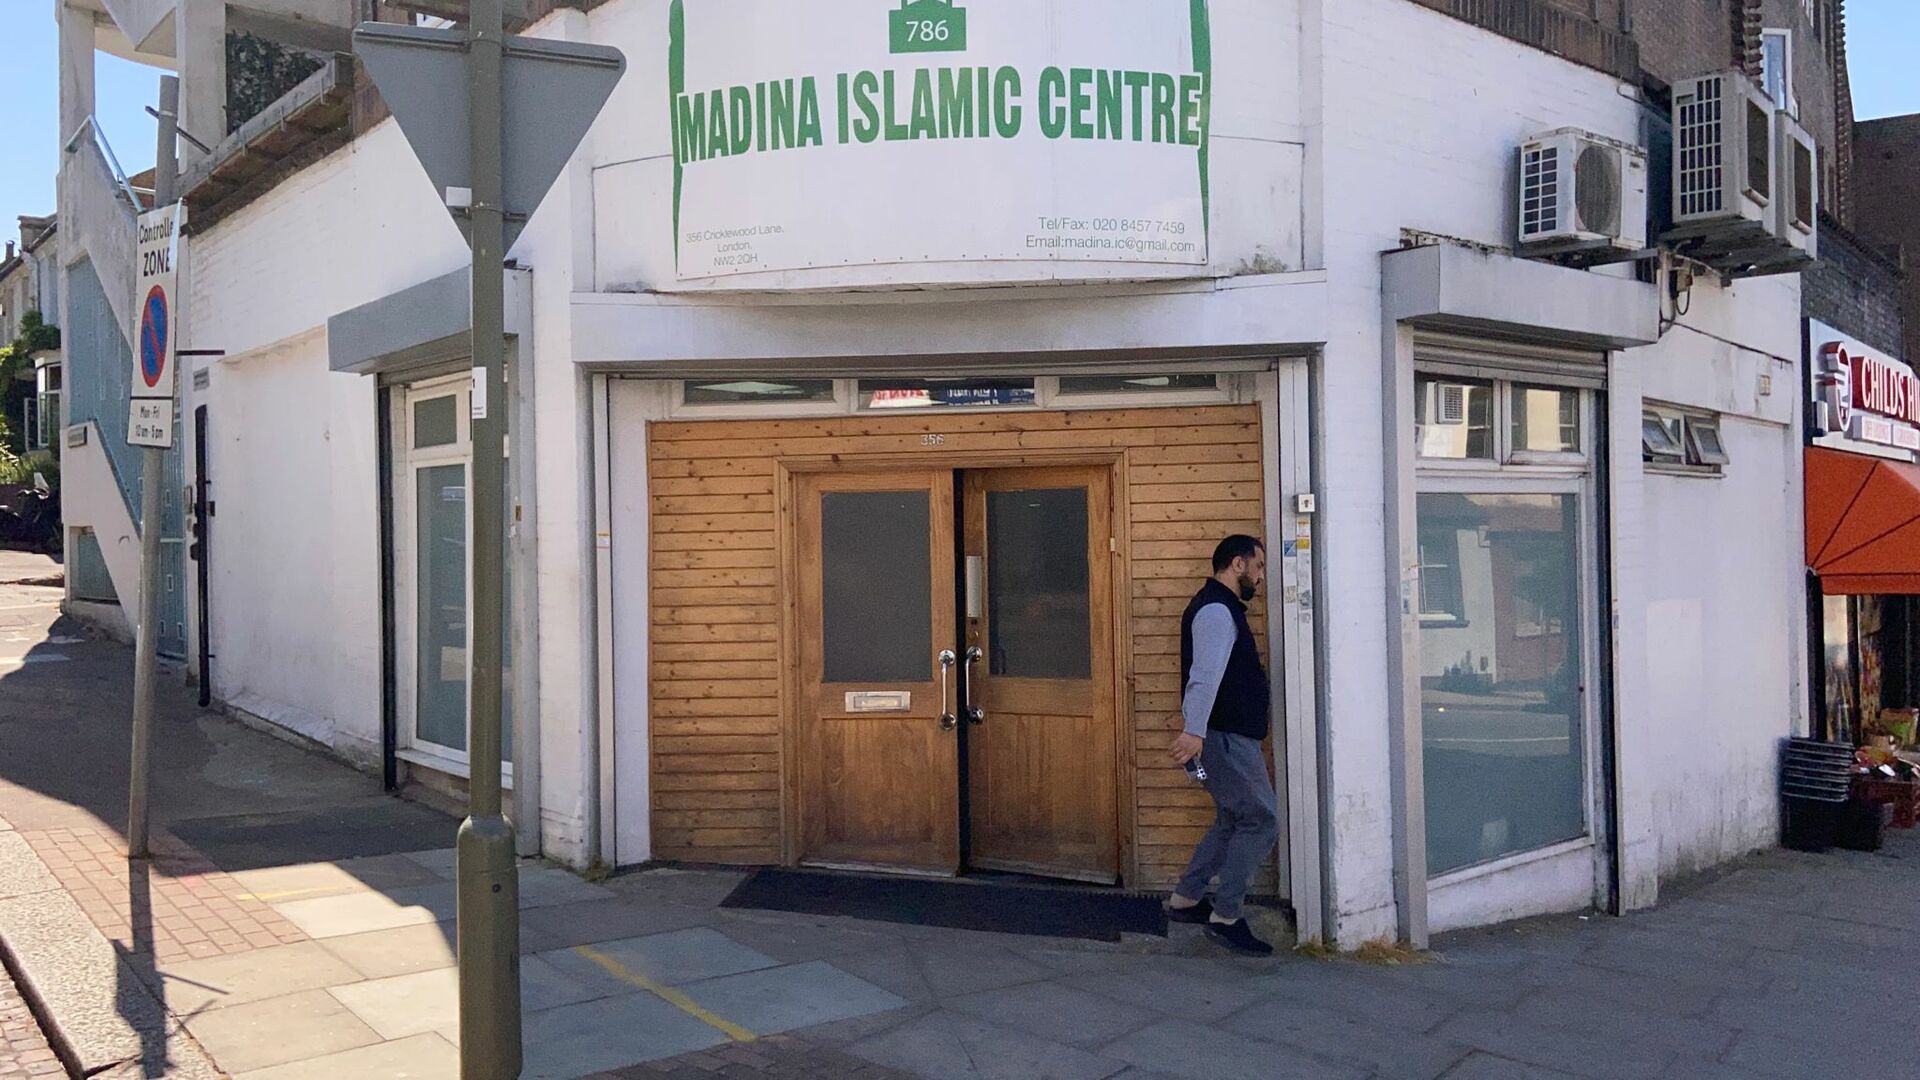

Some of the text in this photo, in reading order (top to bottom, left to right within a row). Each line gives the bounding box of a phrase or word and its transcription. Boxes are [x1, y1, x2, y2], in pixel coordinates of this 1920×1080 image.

[905, 19, 950, 43] 786
[678, 65, 1201, 164] MADINA ISLAMIC CENTRE
[703, 225, 757, 241] Cricklewood
[1038, 216, 1185, 234] Tel/Fax: 020 8457 7459
[143, 247, 171, 277] ZONE
[713, 256, 735, 266] NW2
[1861, 356, 1920, 424] CHILDS HI
[920, 434, 945, 446] 356
